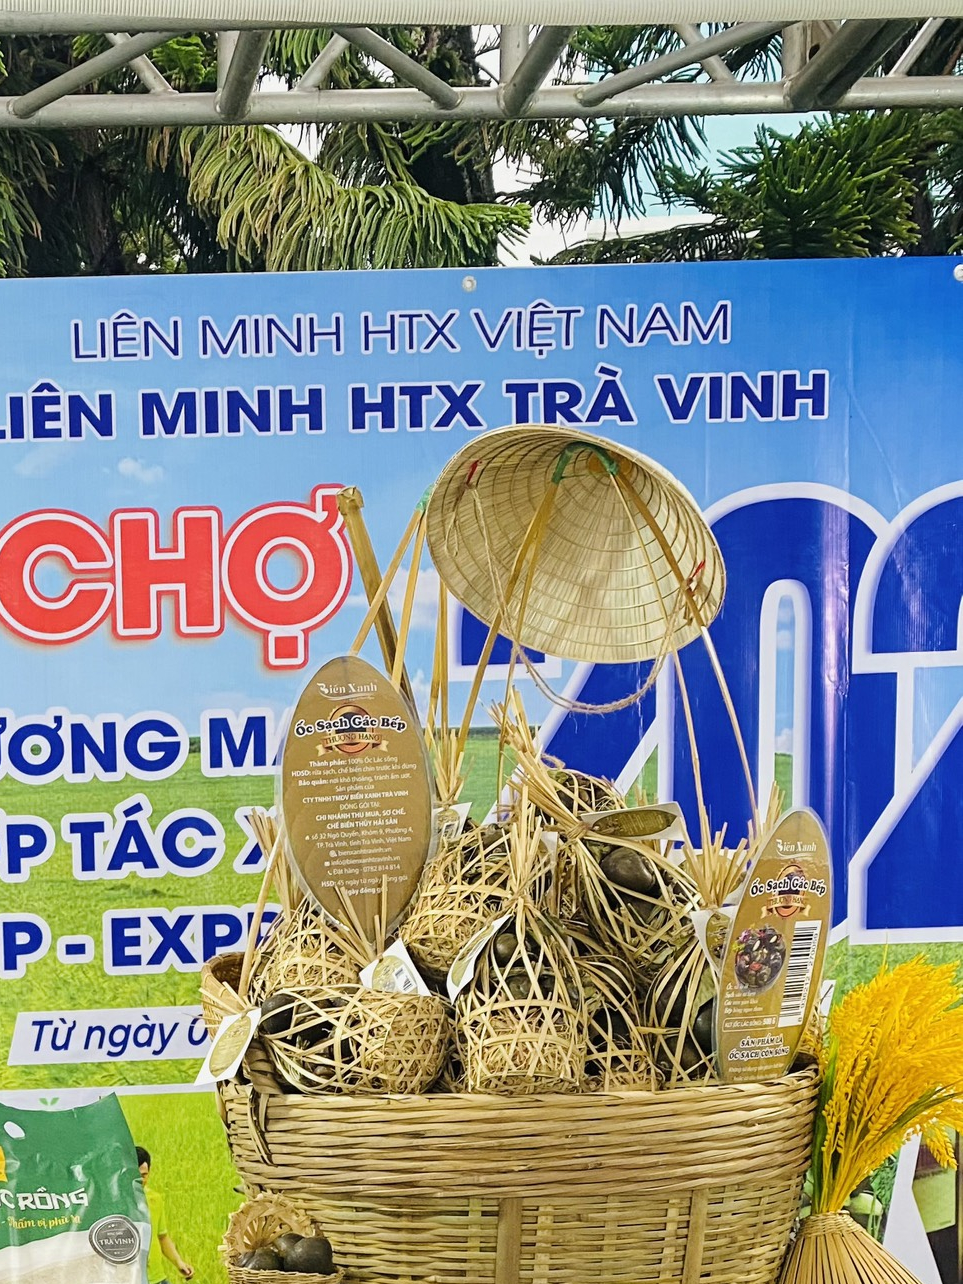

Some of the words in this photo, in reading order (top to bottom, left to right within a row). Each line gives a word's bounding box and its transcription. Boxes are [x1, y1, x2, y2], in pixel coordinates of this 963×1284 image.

[72, 311, 181, 359] LIÊN
[201, 314, 343, 356] MINH
[360, 312, 458, 352] HTX
[473, 302, 580, 358] VIỆT
[599, 303, 729, 345] NAM
[141, 387, 324, 435] MINH
[352, 384, 482, 430] HTX
[505, 366, 635, 427] TRÀ
[656, 372, 826, 420] VINH
[348, 682, 378, 693] Xanh
[295, 721, 313, 736] Ốc
[317, 717, 348, 733] Sạch
[352, 715, 377, 728] Gác
[381, 717, 406, 732] Bếp
[302, 796, 314, 804] CTY
[72, 803, 217, 873] TÁC
[750, 879, 763, 896] Ốc
[766, 879, 789, 892] Sạch
[791, 877, 808, 889] Gác
[811, 881, 826, 896] Bếp
[30, 1016, 77, 1052] Từ
[83, 1013, 179, 1057] ngày
[16, 1186, 89, 1212] RỒNG
[114, 1237, 135, 1245] VINH
